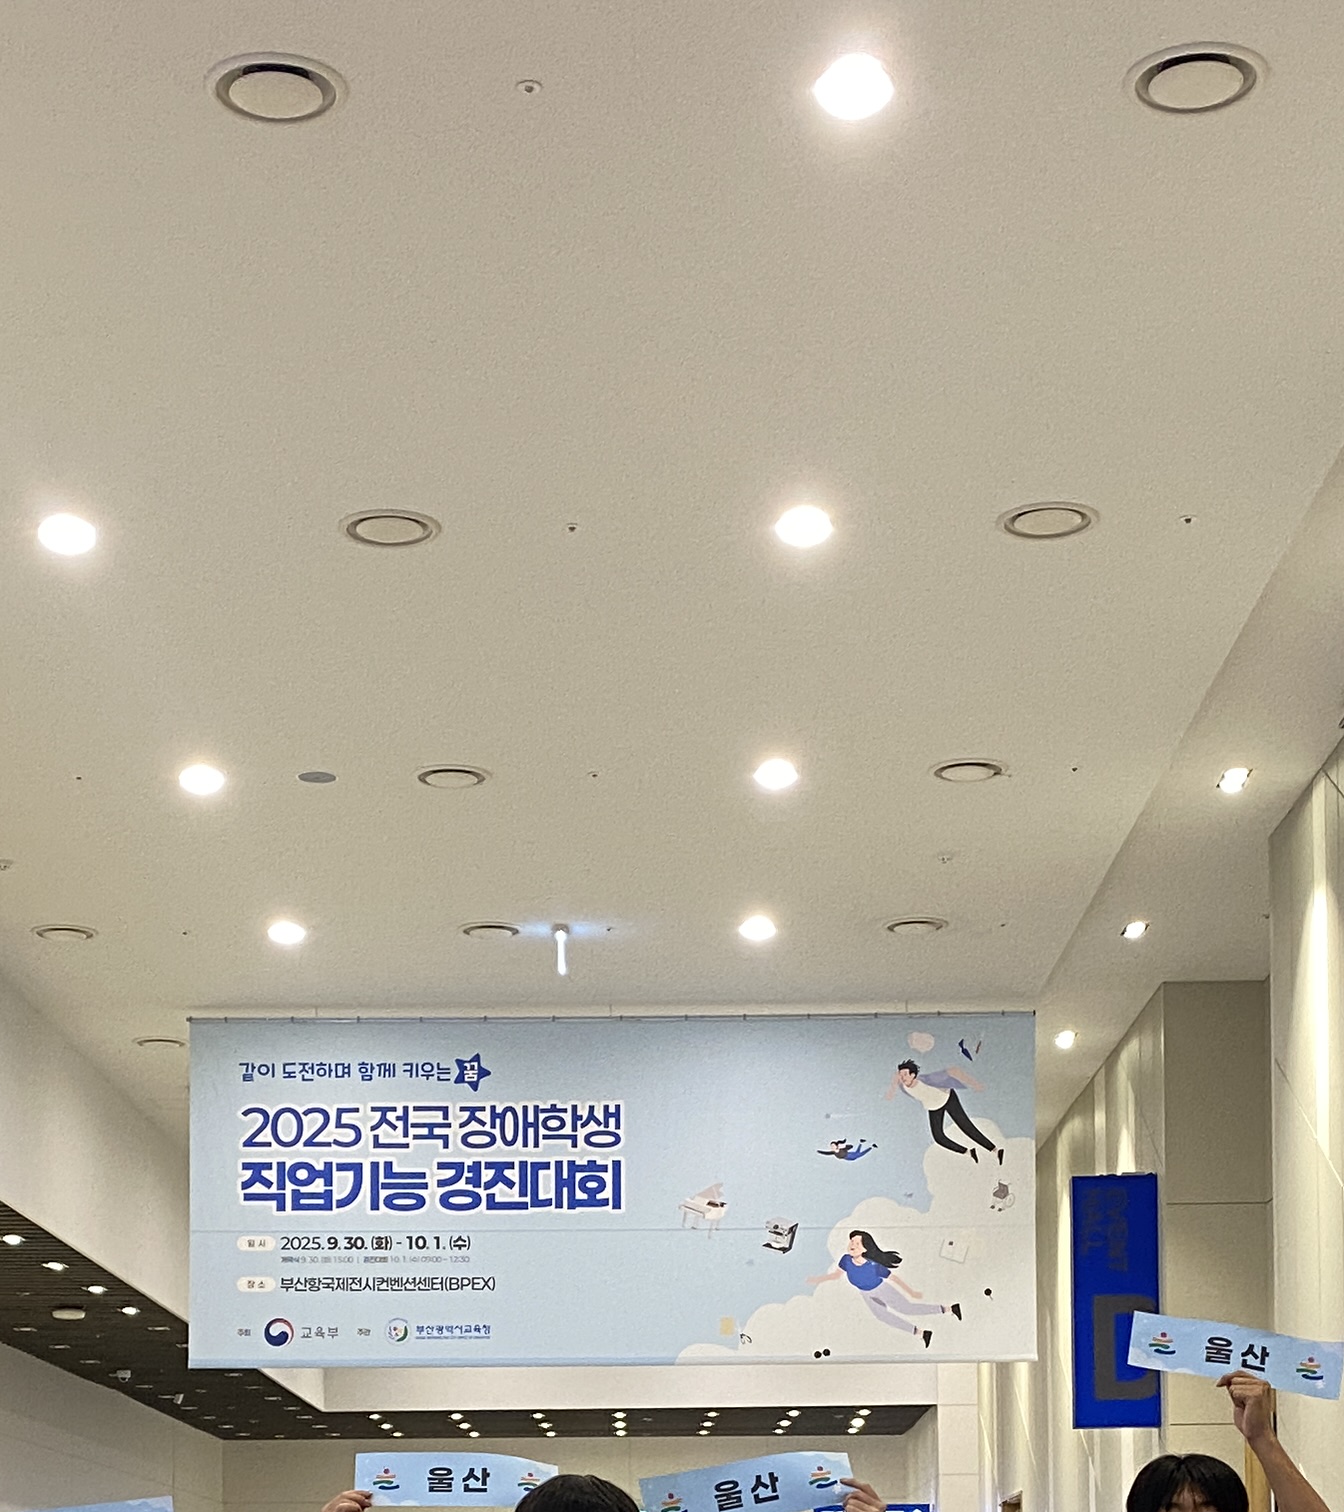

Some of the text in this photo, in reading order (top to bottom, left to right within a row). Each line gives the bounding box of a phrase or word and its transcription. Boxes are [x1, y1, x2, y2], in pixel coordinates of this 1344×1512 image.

[239, 1061, 479, 1082] 같이 도전하며 함께 키우는 꿈
[241, 1103, 622, 1150] 2025 전국 장애학생
[241, 1160, 622, 1212] 직업기능 경진대회
[449, 1235, 471, 1251] (수)
[280, 1276, 496, 1293] 부산항국제전시컨벤션센터(BPEX)
[301, 1326, 339, 1339] 교육부
[1206, 1337, 1270, 1373] 울산
[427, 1467, 491, 1493] 울산
[714, 1471, 780, 1512] 울산
